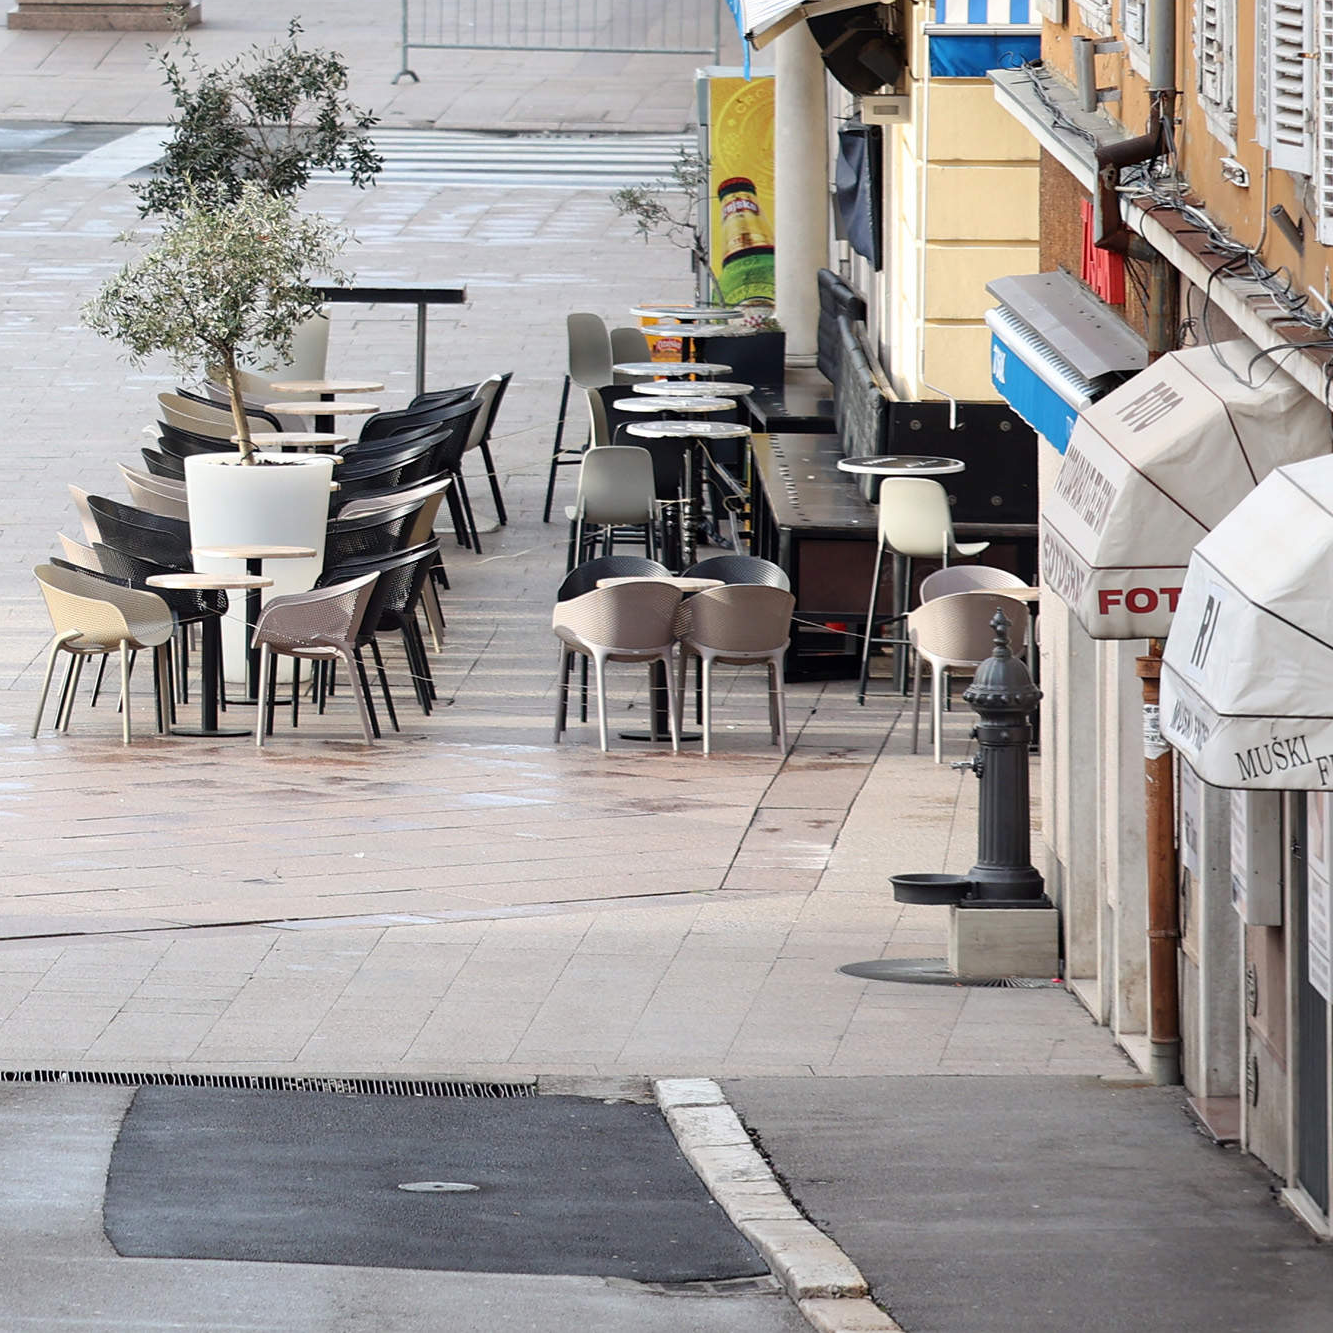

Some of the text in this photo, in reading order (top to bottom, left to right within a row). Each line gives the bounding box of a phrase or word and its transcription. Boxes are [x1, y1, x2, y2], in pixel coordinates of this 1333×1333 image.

[1116, 381, 1184, 433] FOTO
[1098, 587, 1183, 615] FOT
[1190, 594, 1221, 670] RI
[1235, 735, 1312, 781] MUŠKI
